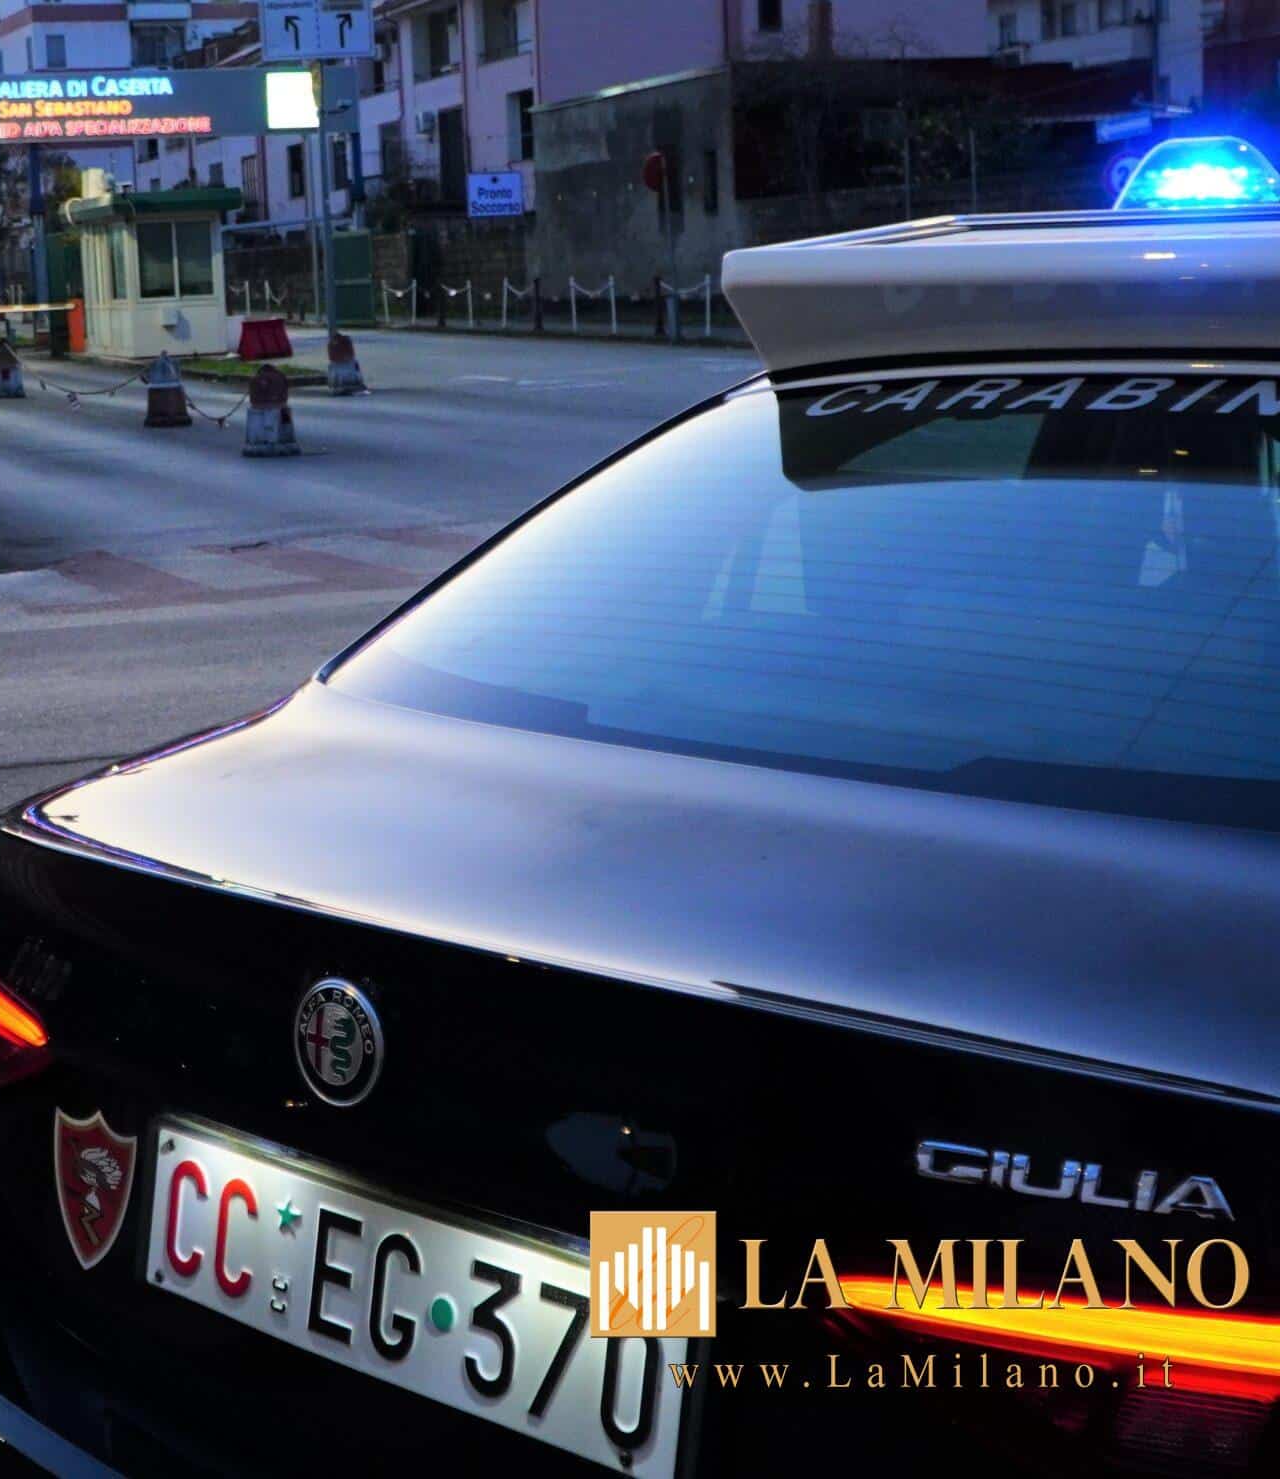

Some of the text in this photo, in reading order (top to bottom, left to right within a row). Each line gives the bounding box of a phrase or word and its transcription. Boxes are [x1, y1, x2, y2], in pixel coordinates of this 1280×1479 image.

[34, 98, 133, 118] SEBASTIANO
[66, 79, 88, 98] DI
[91, 75, 173, 97] CASERTA
[916, 1139, 1236, 1221] GIULIA
[166, 1159, 259, 1297] CC
